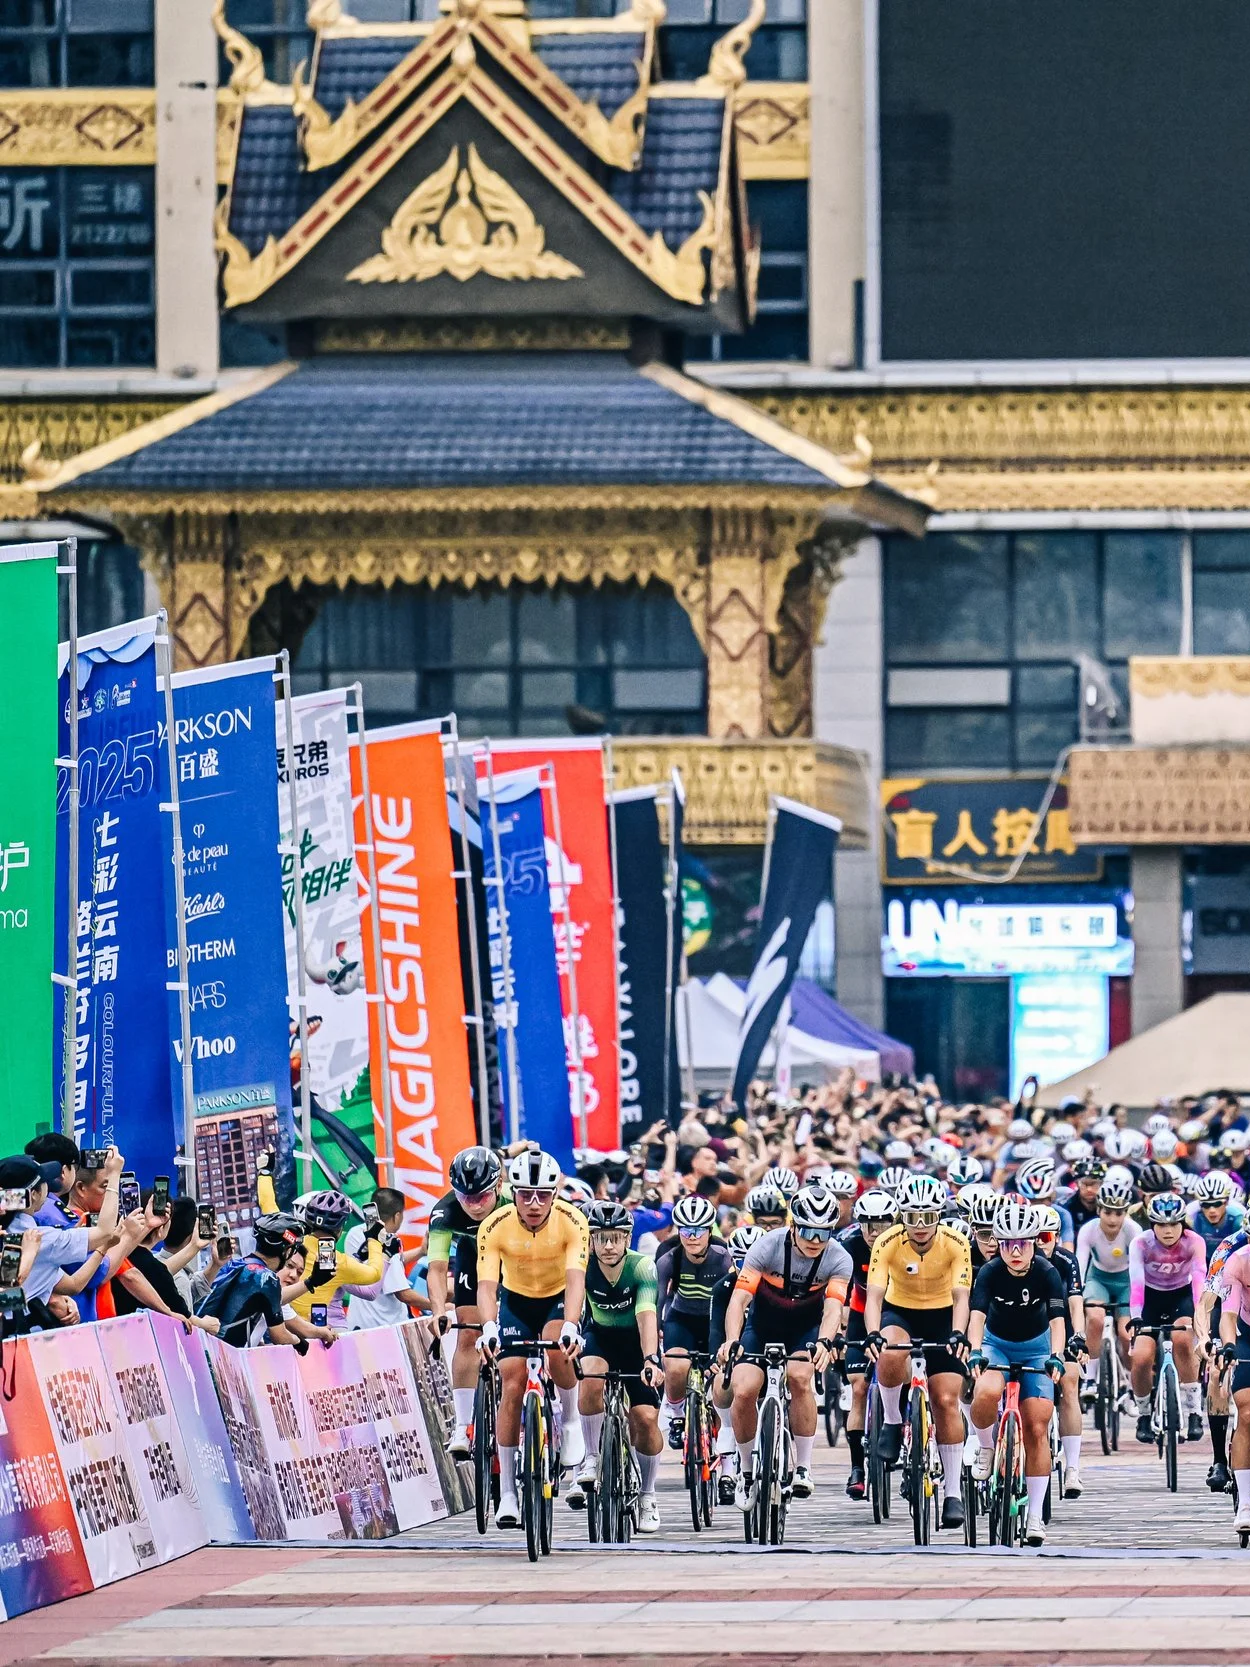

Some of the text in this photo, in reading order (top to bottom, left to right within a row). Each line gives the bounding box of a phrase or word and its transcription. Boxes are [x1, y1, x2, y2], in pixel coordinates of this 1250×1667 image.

[178, 748, 220, 782] 百盛
[203, 843, 229, 863] peau
[95, 811, 119, 985] 七彩云南
[184, 892, 225, 918] Kiehl's
[167, 937, 236, 969] BIOTHERM
[372, 793, 445, 1238] MAGICSHINE
[102, 992, 115, 1124] COLOURFUL
[173, 1036, 236, 1063] Whoo
